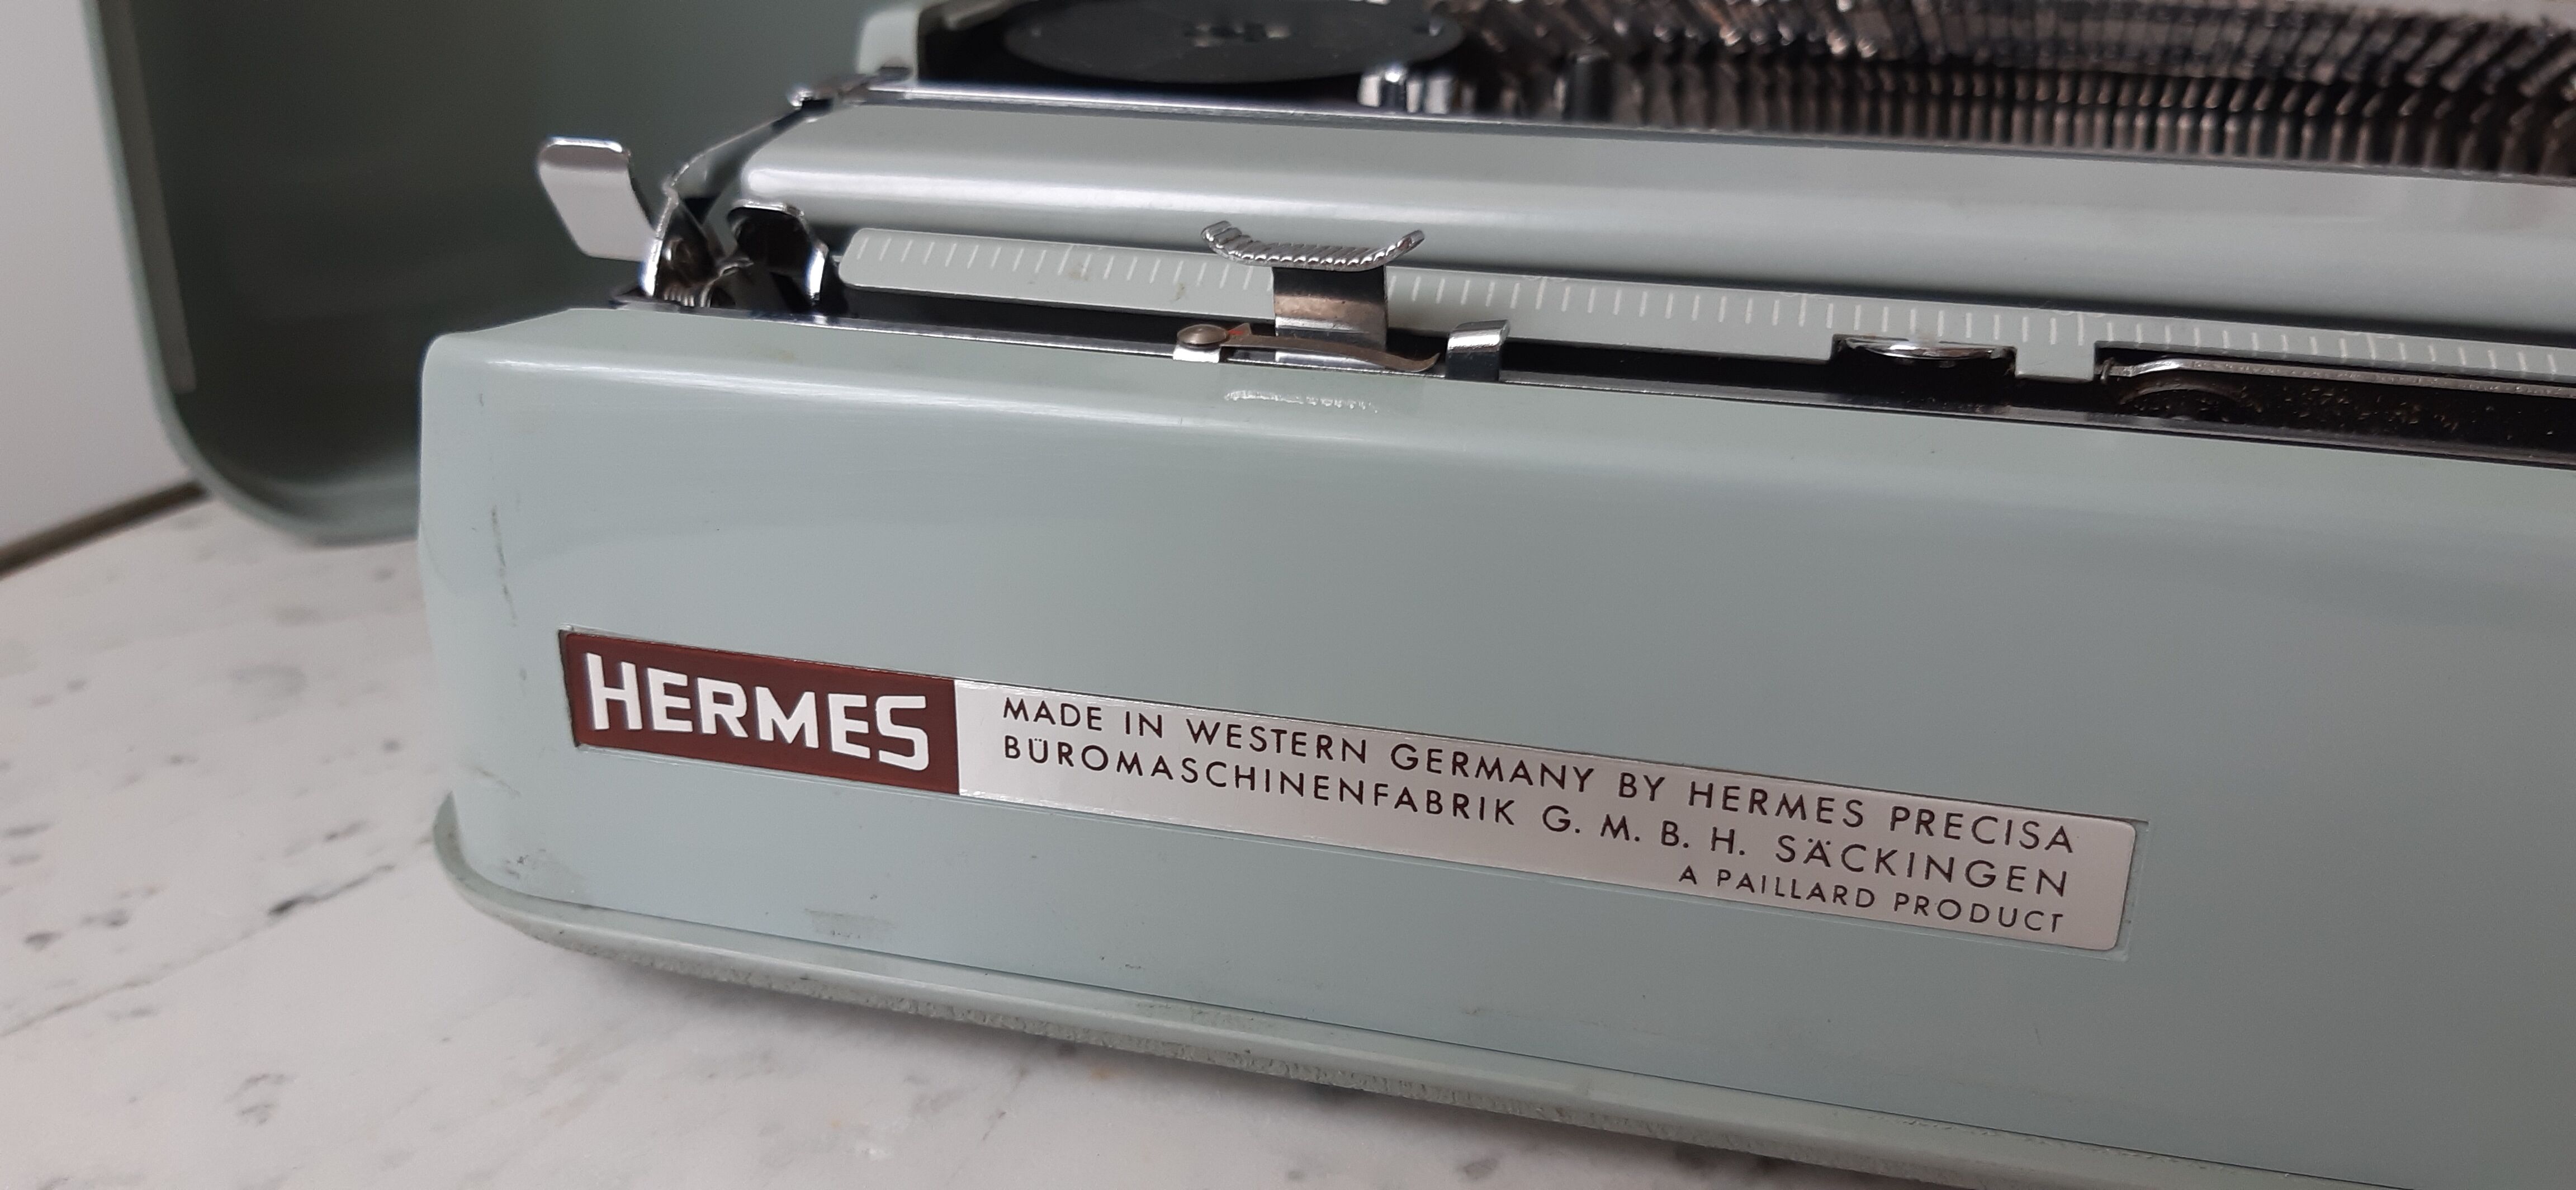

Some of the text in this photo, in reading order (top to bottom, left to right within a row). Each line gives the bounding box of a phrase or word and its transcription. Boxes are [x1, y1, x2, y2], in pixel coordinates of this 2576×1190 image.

[585, 652, 930, 771] HERMES
[1003, 696, 2074, 854] MADE IN WESTERN GERMANY BY HERMES PRECISA
[1004, 734, 2068, 898] BÜROMASCHINENFABRIK G. M. B. H. SÄCKINGEN
[1678, 864, 2064, 934] A PAILLARD PRODUCT
